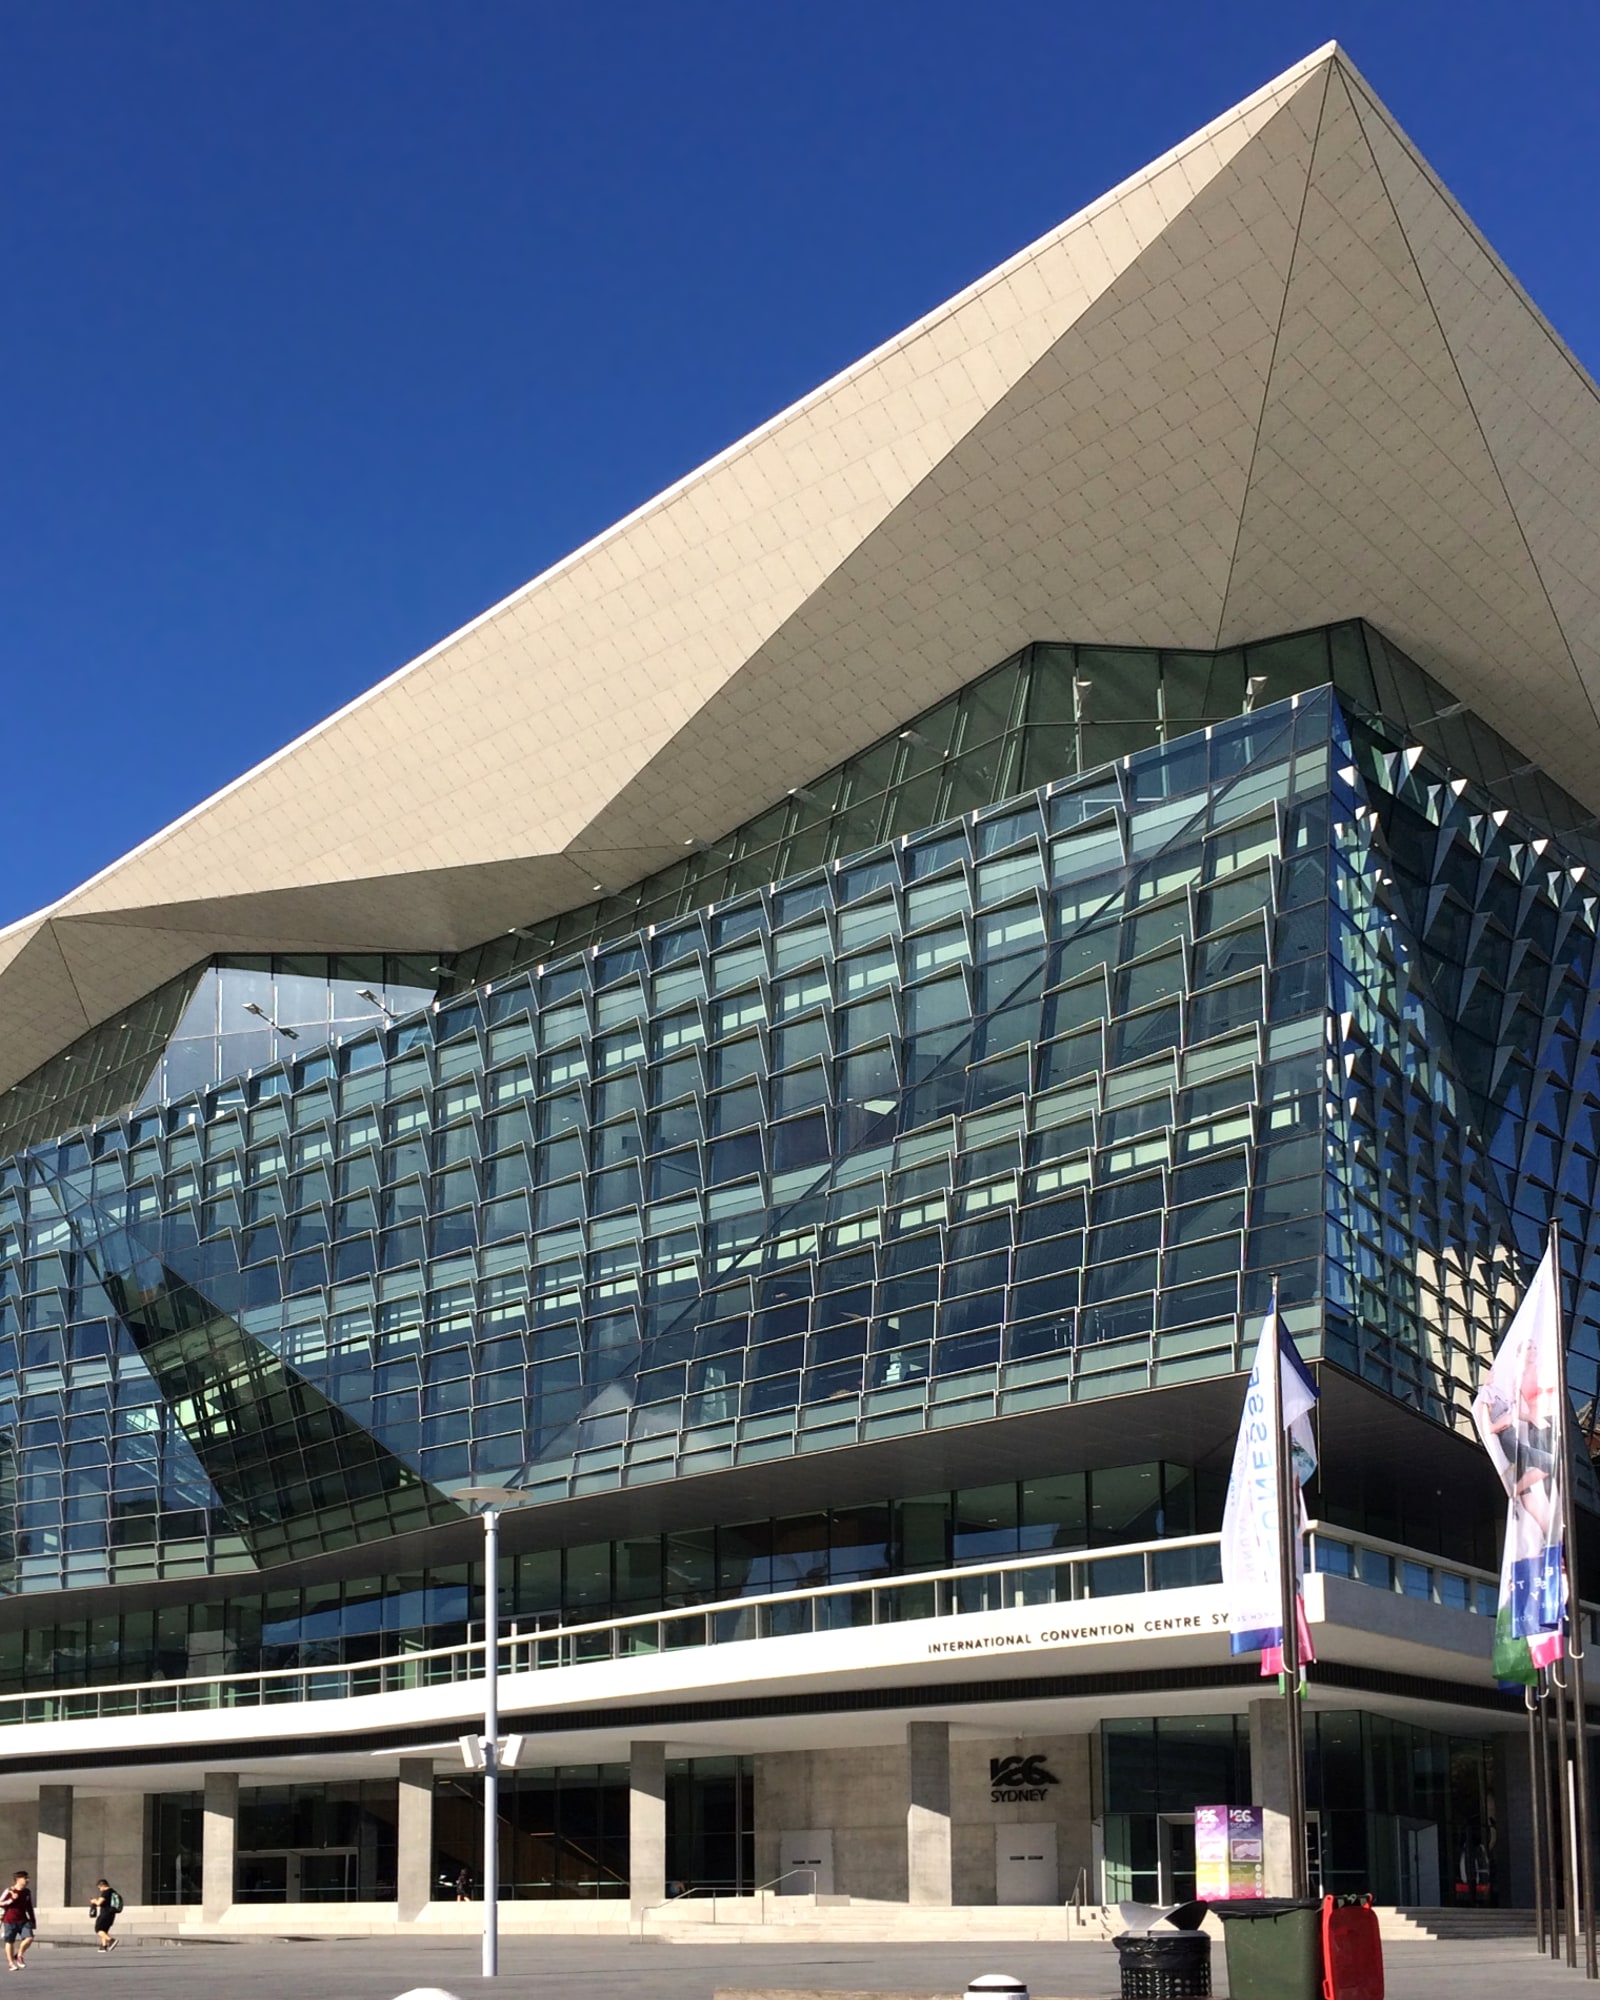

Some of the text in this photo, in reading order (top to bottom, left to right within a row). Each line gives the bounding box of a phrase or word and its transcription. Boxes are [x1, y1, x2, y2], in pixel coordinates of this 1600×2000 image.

[928, 1634, 1032, 1654] INTERNATIONAL
[1041, 1623, 1135, 1643] CONVENTION
[1144, 1616, 1202, 1632] CENTRE
[991, 1788, 1048, 1803] SYDNEY
